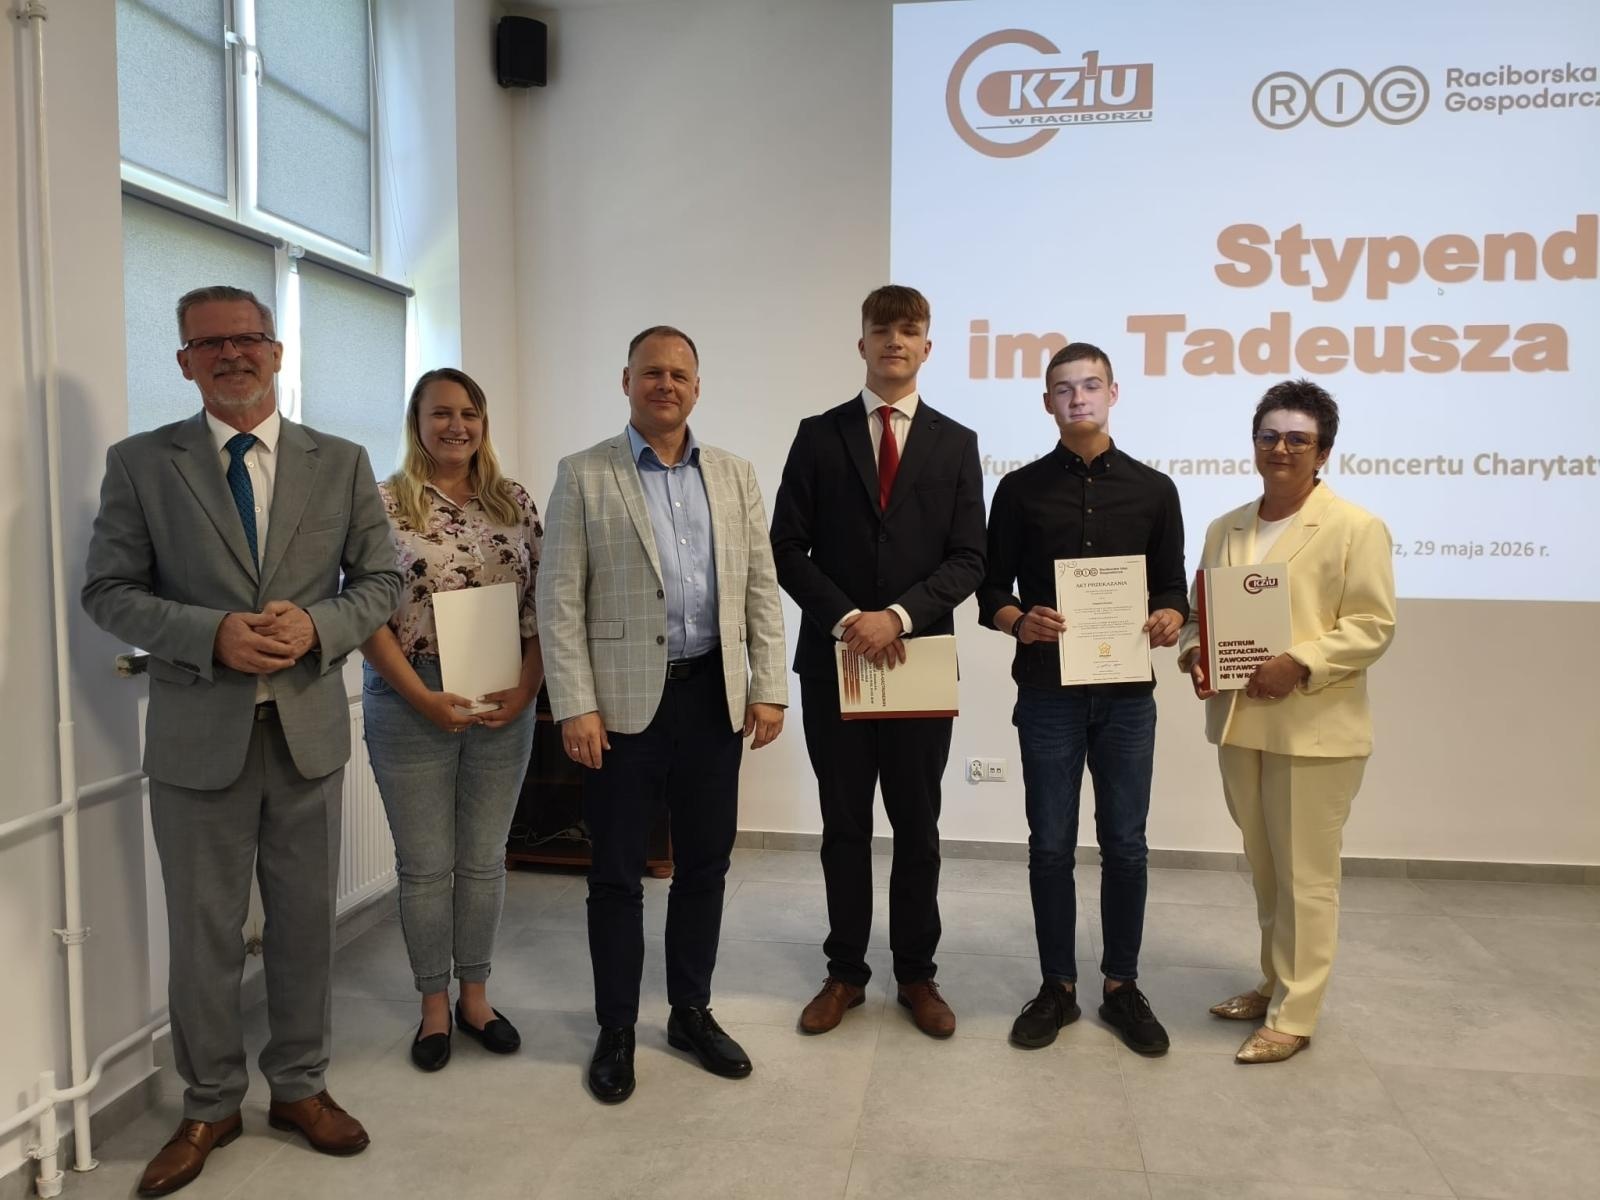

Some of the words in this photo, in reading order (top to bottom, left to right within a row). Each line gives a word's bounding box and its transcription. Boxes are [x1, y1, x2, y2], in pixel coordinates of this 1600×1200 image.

[1446, 62, 1597, 88] Raciborska
[1030, 110, 1153, 124] RACIBORZU
[1214, 214, 1599, 302] Stypend
[1126, 312, 1570, 377] Tadeusza
[1168, 456, 1257, 476] ramac
[1339, 453, 1464, 477] Koncertu
[1472, 452, 1600, 481] Charytat
[1413, 541, 1436, 556] 29
[1440, 541, 1485, 559] maja
[1489, 541, 1535, 557] 2026
